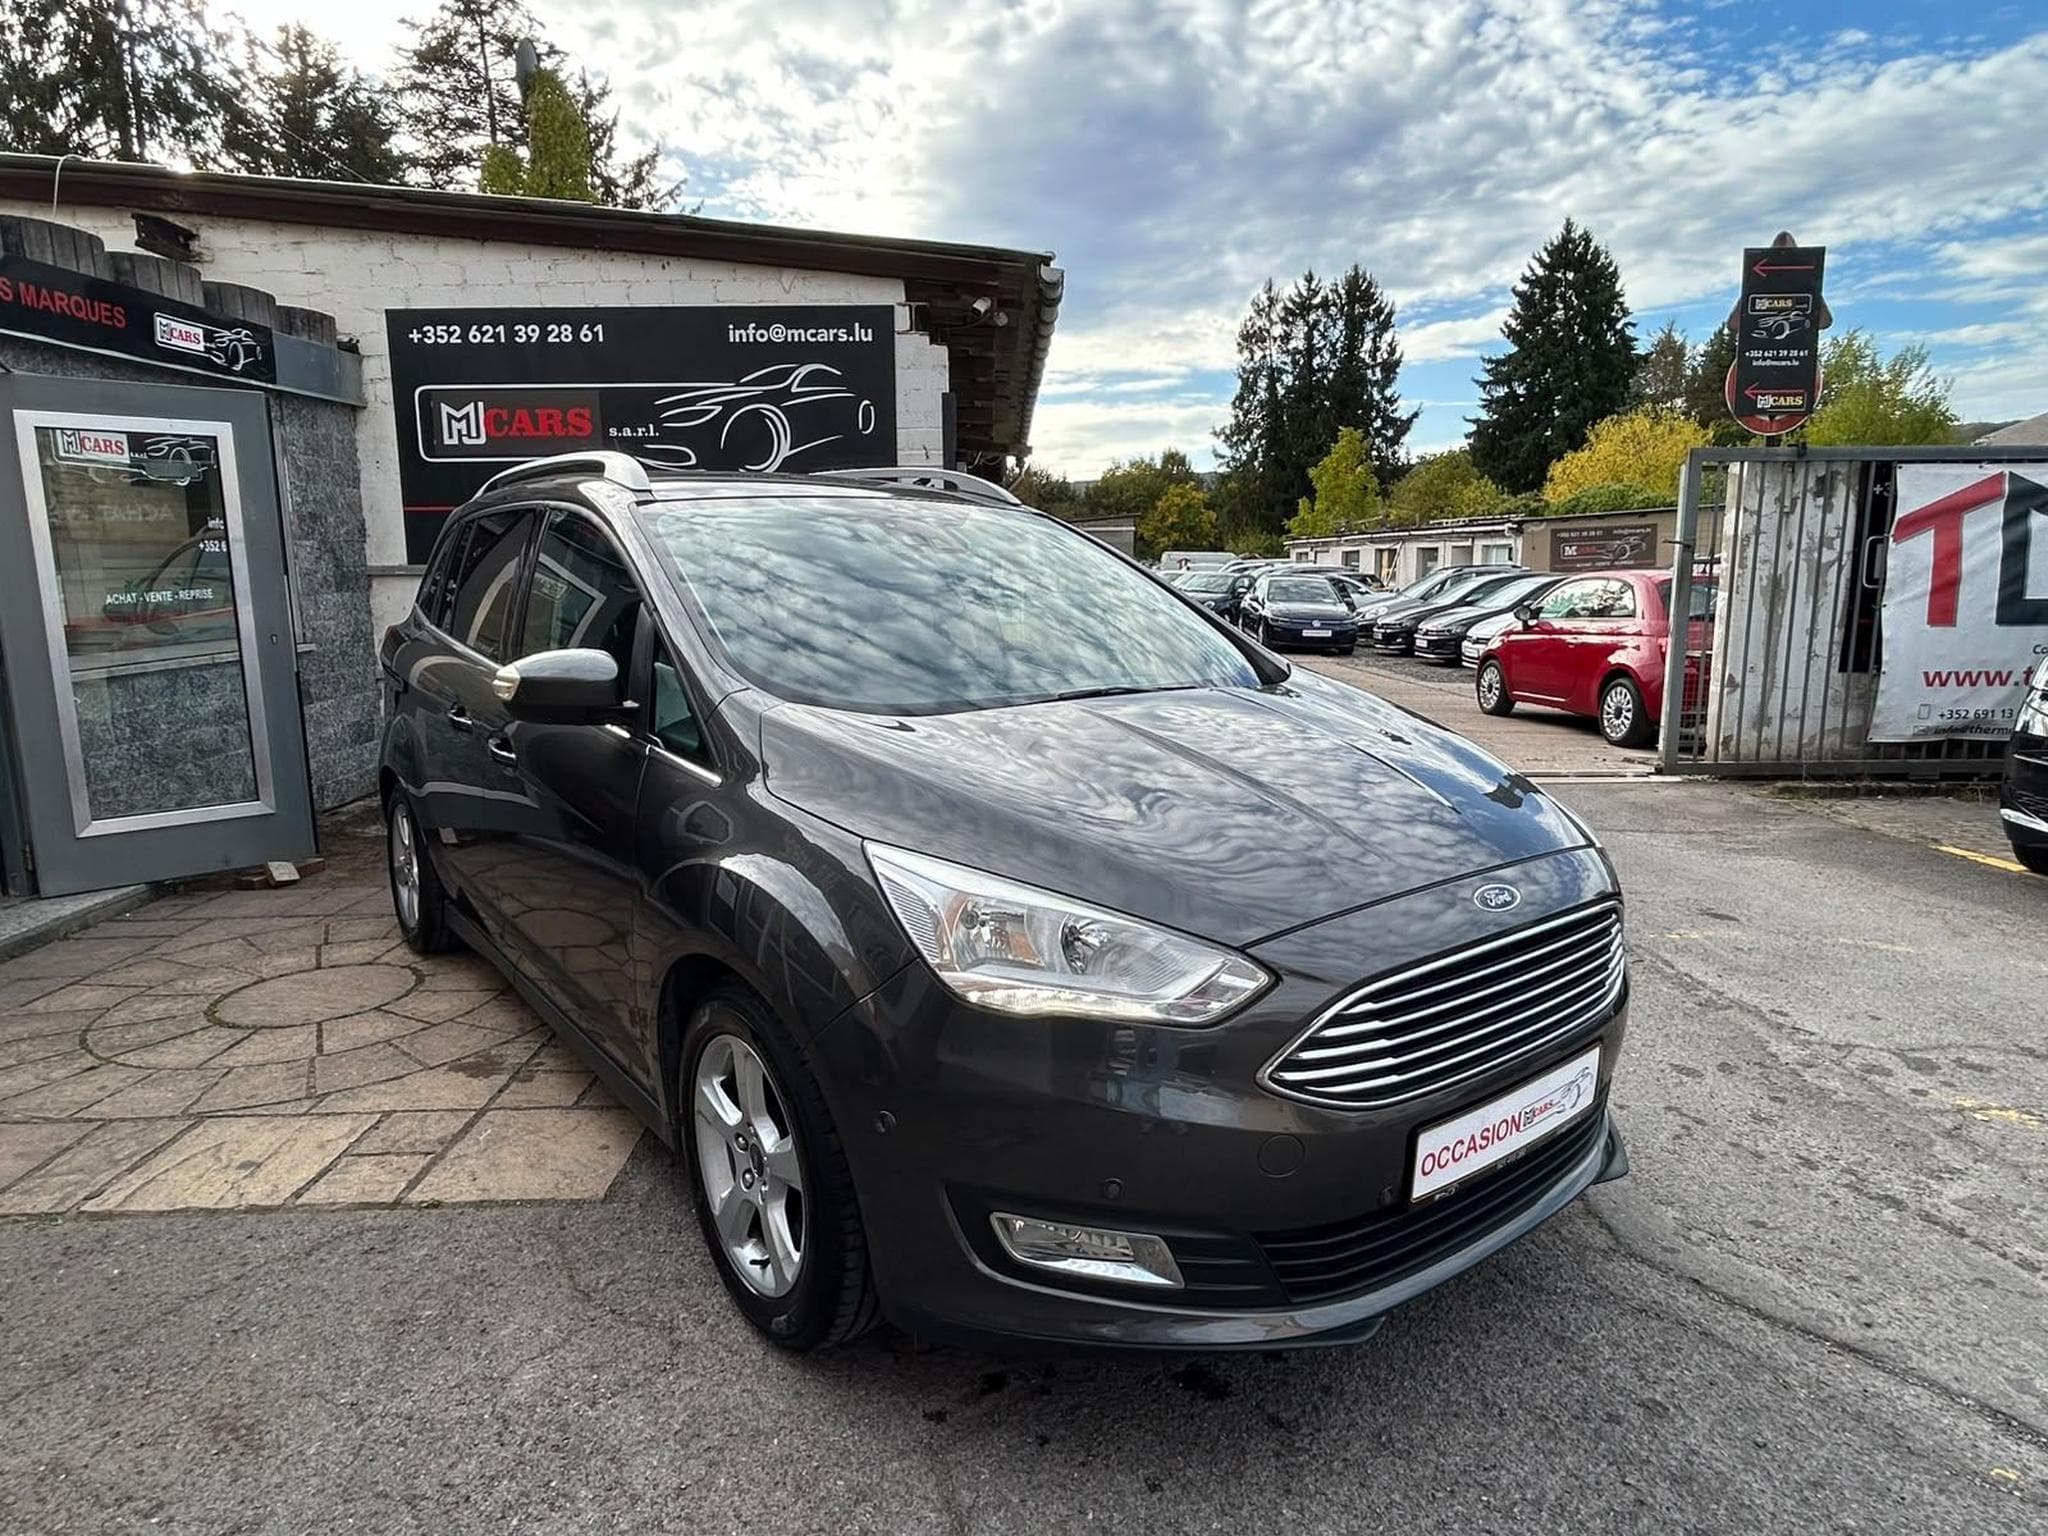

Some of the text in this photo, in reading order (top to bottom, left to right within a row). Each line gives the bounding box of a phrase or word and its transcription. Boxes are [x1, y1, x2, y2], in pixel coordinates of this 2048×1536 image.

[19, 281, 128, 329] MARQUES
[408, 323, 605, 344] +352 621 39 28 61
[728, 322, 874, 343] info@mcars.lu
[608, 423, 660, 438] s.a.r.l.
[105, 592, 138, 605] ACHAT
[144, 590, 172, 603] VENTE
[178, 588, 214, 601] REPRISE
[1938, 708, 2014, 720] +352 691 13
[1421, 1111, 1522, 1177] OCCASION
